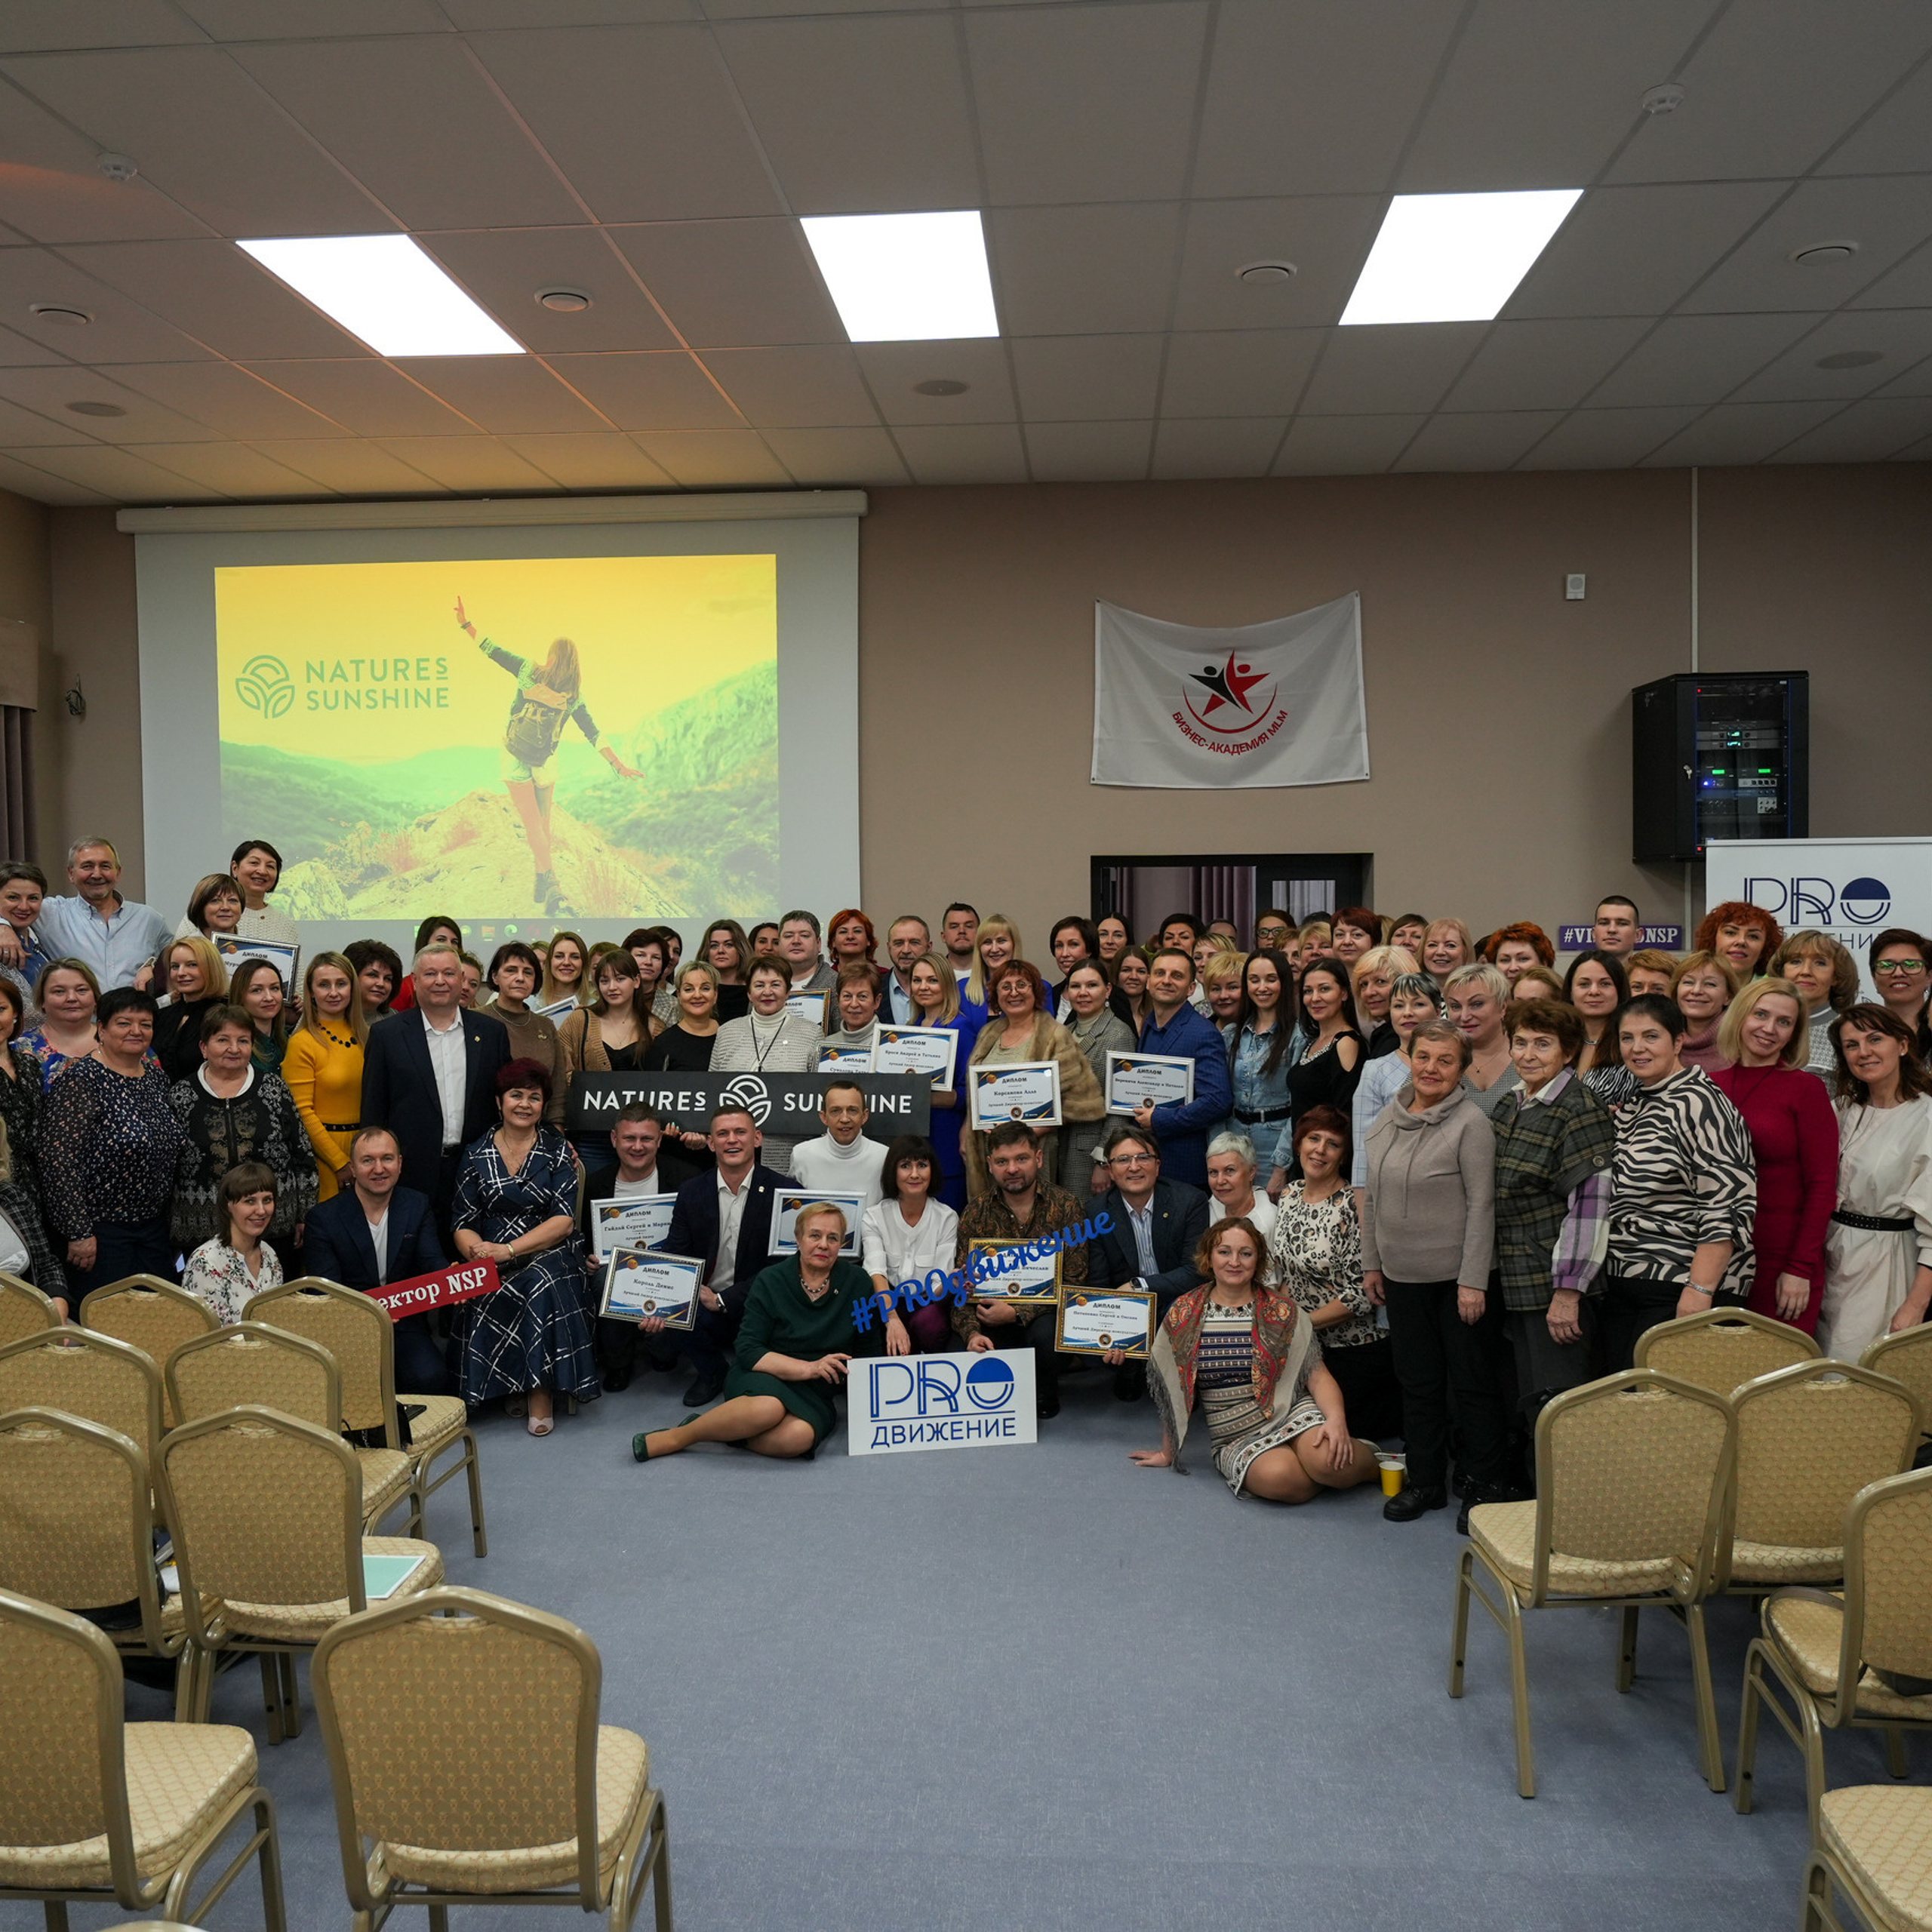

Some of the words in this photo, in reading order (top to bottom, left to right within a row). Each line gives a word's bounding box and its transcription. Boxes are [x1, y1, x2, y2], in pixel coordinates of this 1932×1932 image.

[306, 657, 448, 683] NATURES
[306, 688, 449, 711] SUNSHINE
[1173, 711, 1269, 756] БИЗНЕС-АКАДЕМИЯ
[1267, 710, 1288, 737] MLM
[783, 1093, 912, 1114] SUINE
[642, 1267, 670, 1275] ДИПЛОМ
[377, 1283, 441, 1311] ектор
[446, 1267, 487, 1294] NSP
[869, 1357, 1014, 1418] PRO
[871, 1417, 1017, 1449] ДВИЖЕНИЕ
